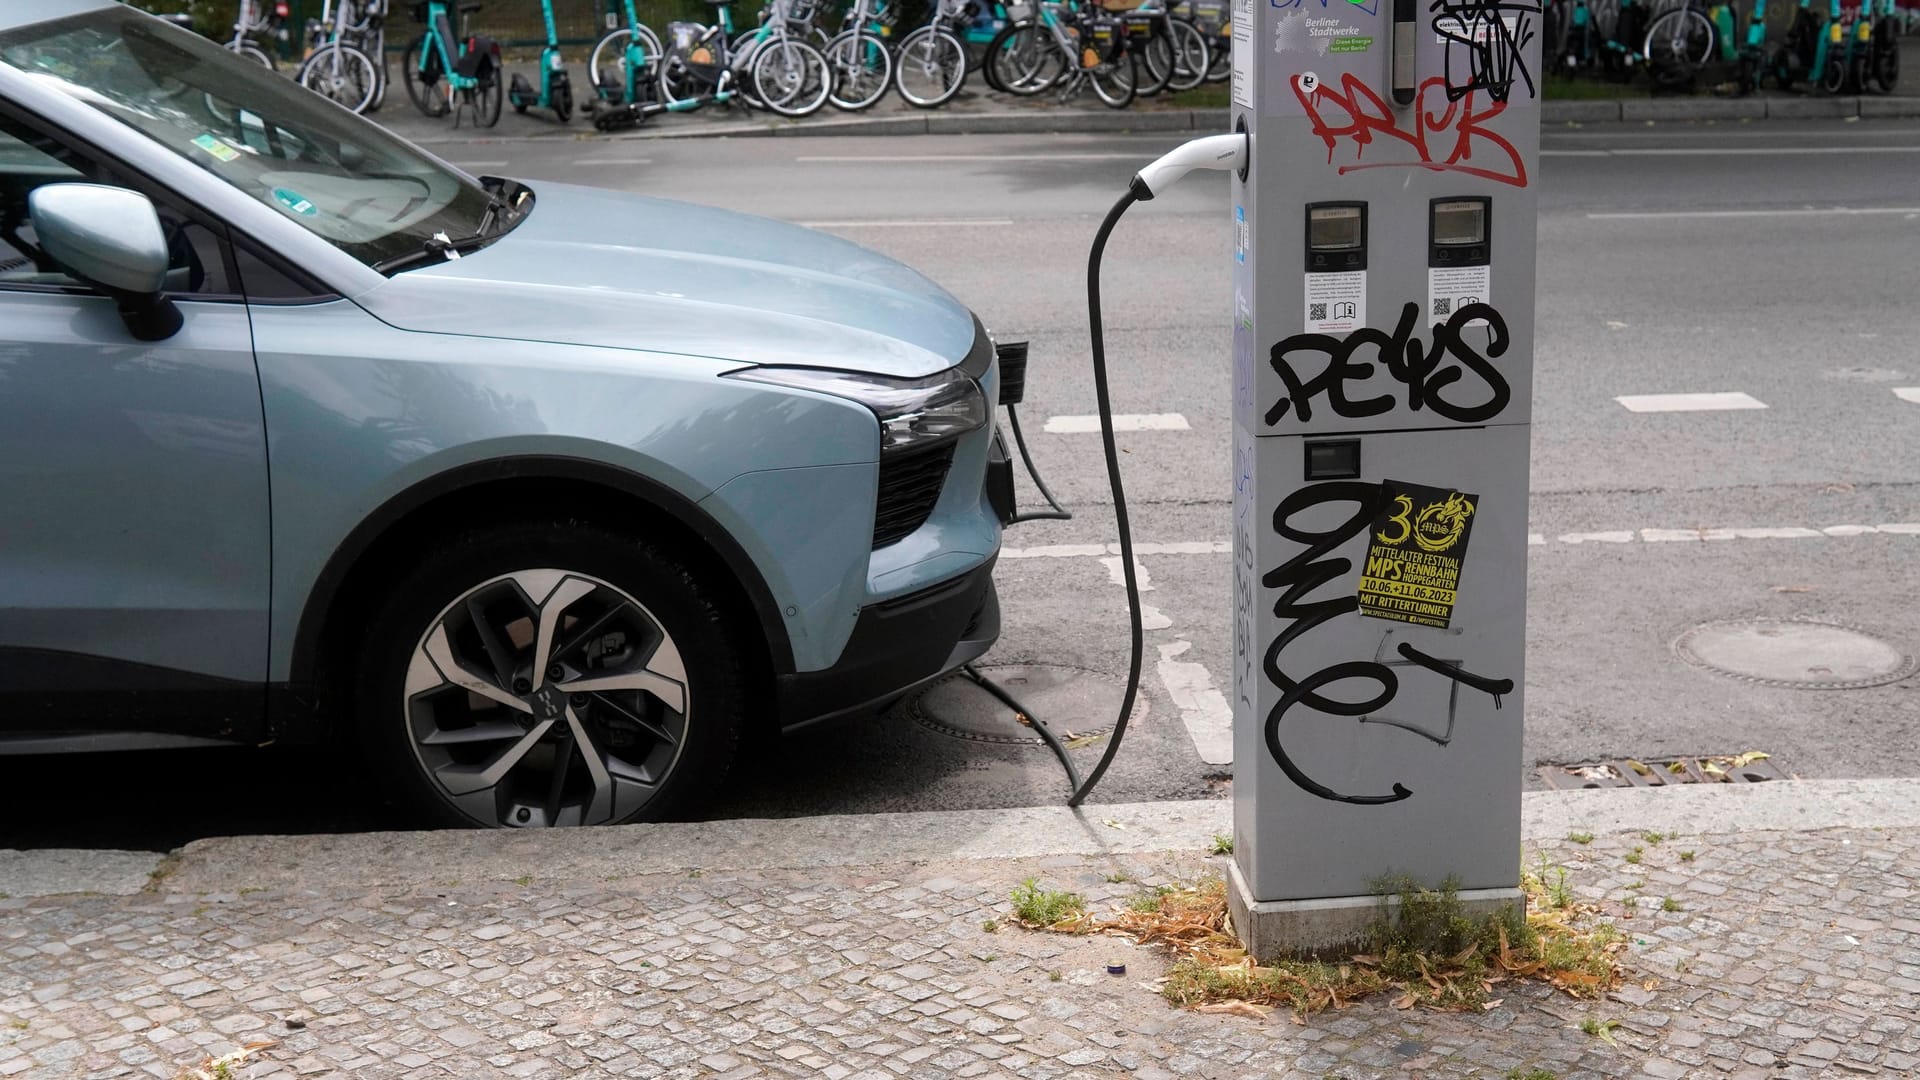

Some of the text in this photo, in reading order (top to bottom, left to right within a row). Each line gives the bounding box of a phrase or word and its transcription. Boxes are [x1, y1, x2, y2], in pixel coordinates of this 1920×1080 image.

[1305, 17, 1340, 28] Berliner
[1309, 25, 1360, 37] Stadtwerke
[1351, 38, 1372, 46] Energie
[1371, 545, 1459, 569] MITTELALTER FESTIVAL
[1366, 556, 1458, 580] MPS RENNBAHN
[1402, 573, 1455, 589] HOPPEGARTEN
[1360, 593, 1448, 616] MIT RITTERTURNIER
